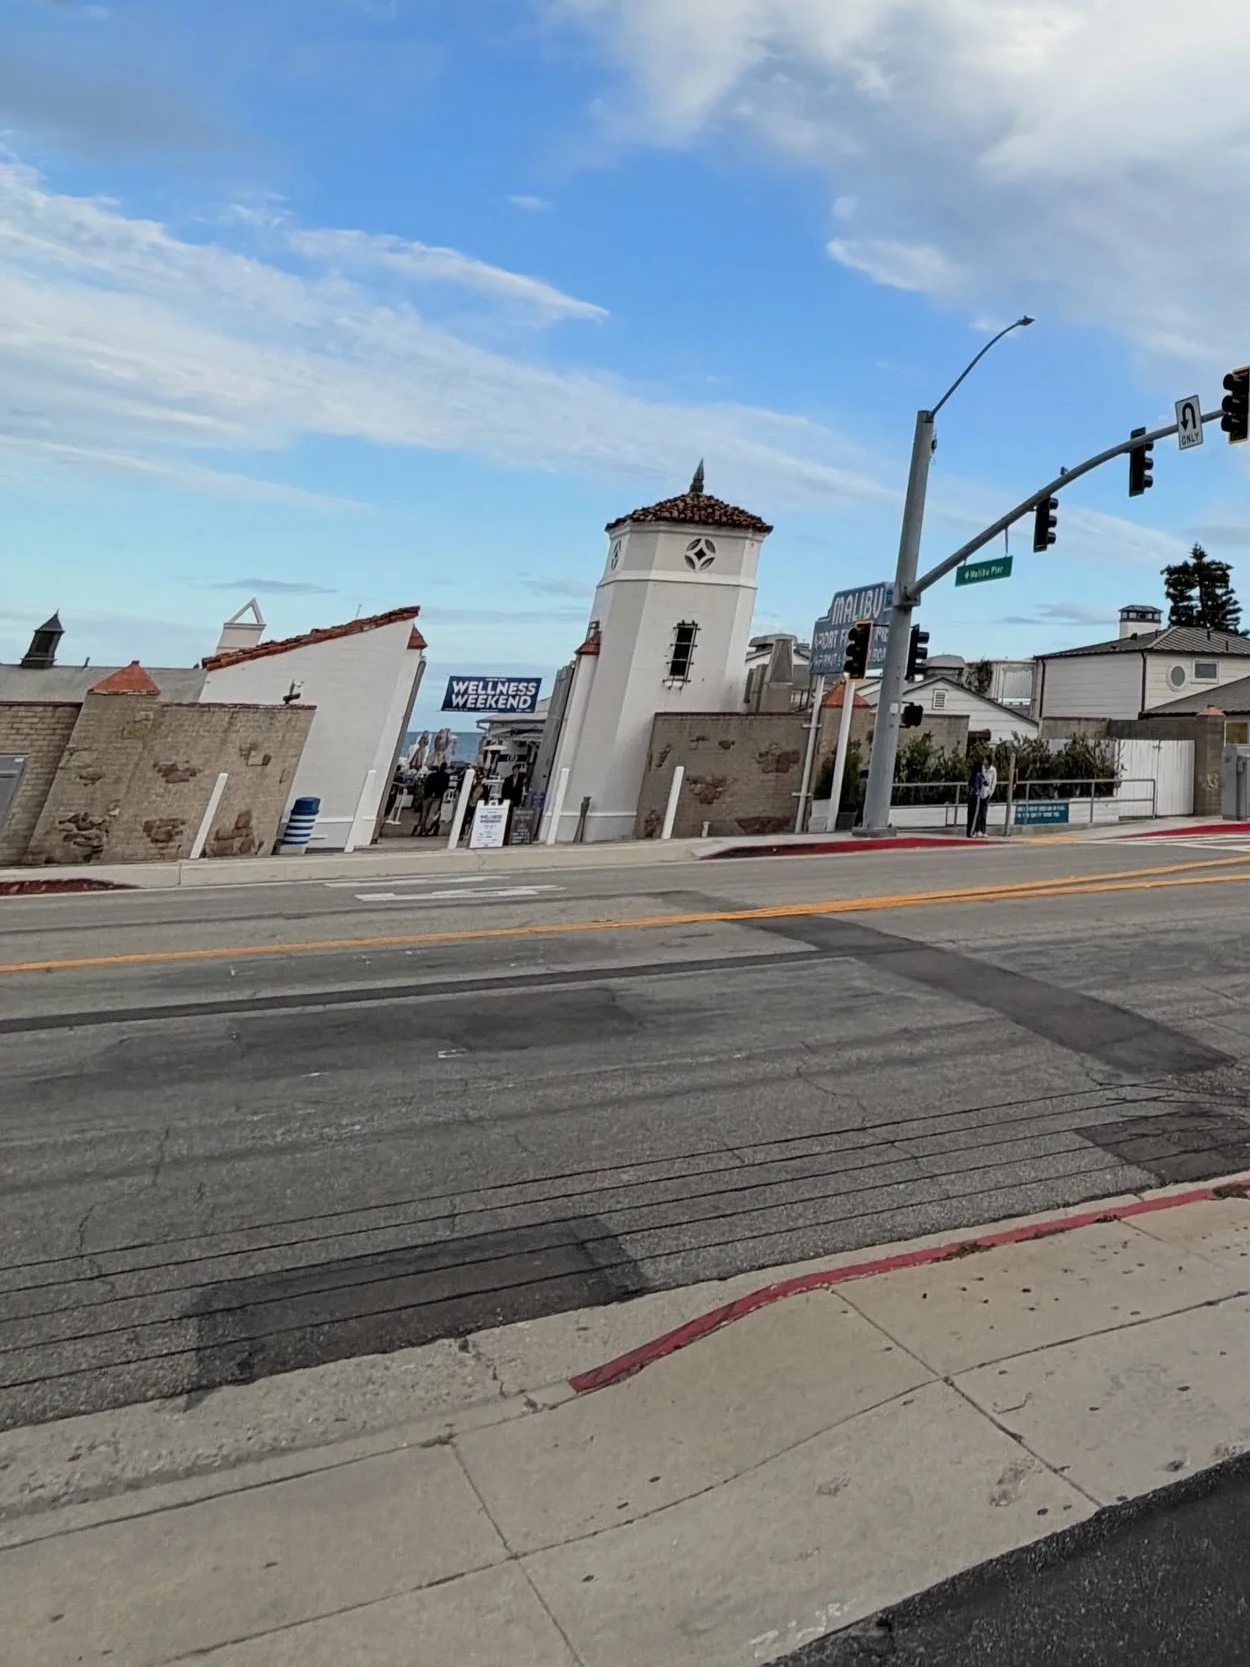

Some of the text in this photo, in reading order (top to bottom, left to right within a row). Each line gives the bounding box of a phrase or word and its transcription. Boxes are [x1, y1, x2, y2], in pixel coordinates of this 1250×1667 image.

[1181, 431, 1199, 445] ONLY
[832, 588, 883, 625] MALIBU
[452, 680, 537, 695] WELLNESS
[451, 694, 532, 709] WEEKEND
